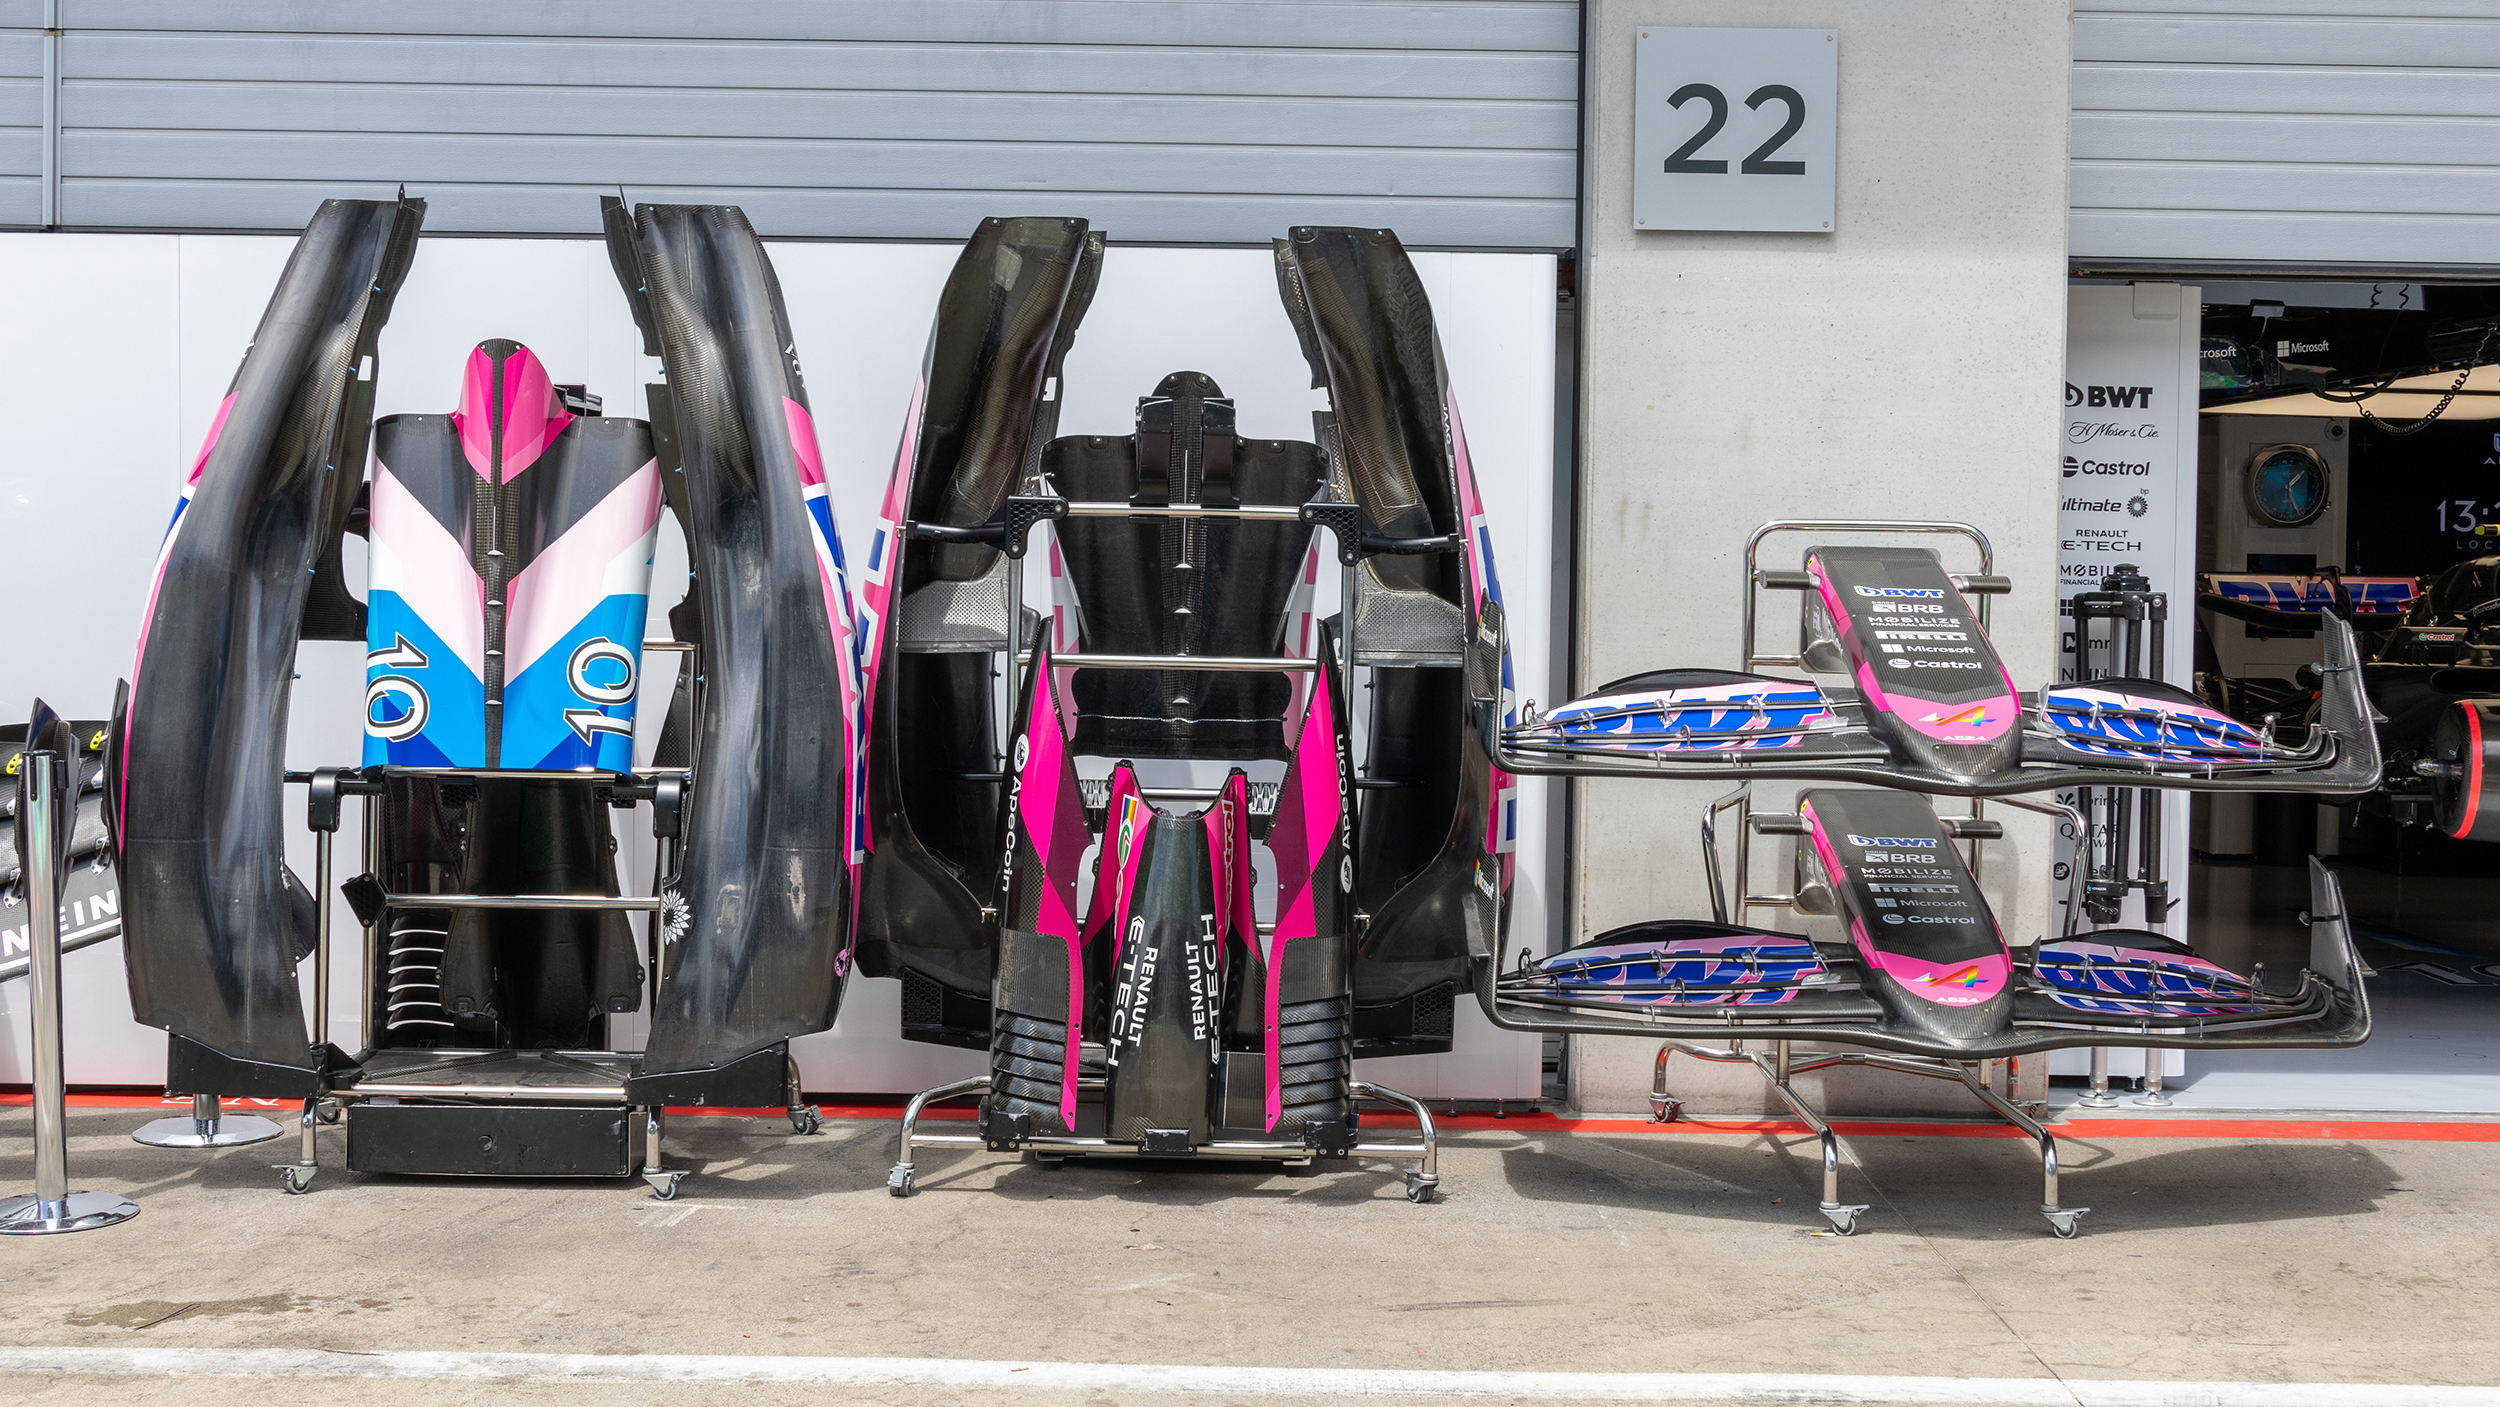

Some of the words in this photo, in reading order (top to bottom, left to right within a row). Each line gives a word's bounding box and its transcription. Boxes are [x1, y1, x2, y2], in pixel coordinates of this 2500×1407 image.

[1663, 82, 1806, 176] 22
[2291, 340, 2329, 354] Microsoft
[2088, 385, 2153, 409] BWT
[2082, 460, 2150, 476] Castrol
[2140, 487, 2150, 495] bp
[2075, 529, 2128, 538] RENAULT
[2061, 539, 2142, 551] E-TECH
[2456, 540, 2500, 550] LOC
[1881, 586, 1945, 599] BWT
[1898, 604, 1944, 614] BRB
[1874, 630, 1968, 641] PIRELLI
[2427, 633, 2455, 641] Castrol
[1906, 645, 1976, 654] Microsoft
[1913, 660, 1982, 669] Castrol
[364, 631, 430, 743] 10
[563, 636, 639, 747] 10
[1336, 733, 1350, 851] ApeCoin
[1001, 776, 1023, 893] ApeCoin
[1876, 836, 1938, 849] BWT
[1890, 854, 1936, 864] BRB
[1868, 883, 1960, 894] PIRELLI
[1900, 899, 1968, 908] Microsoft
[1907, 915, 1976, 925] Castrol
[1128, 947, 1158, 1047] RENAULT
[1185, 941, 1206, 1041] RENAULT
